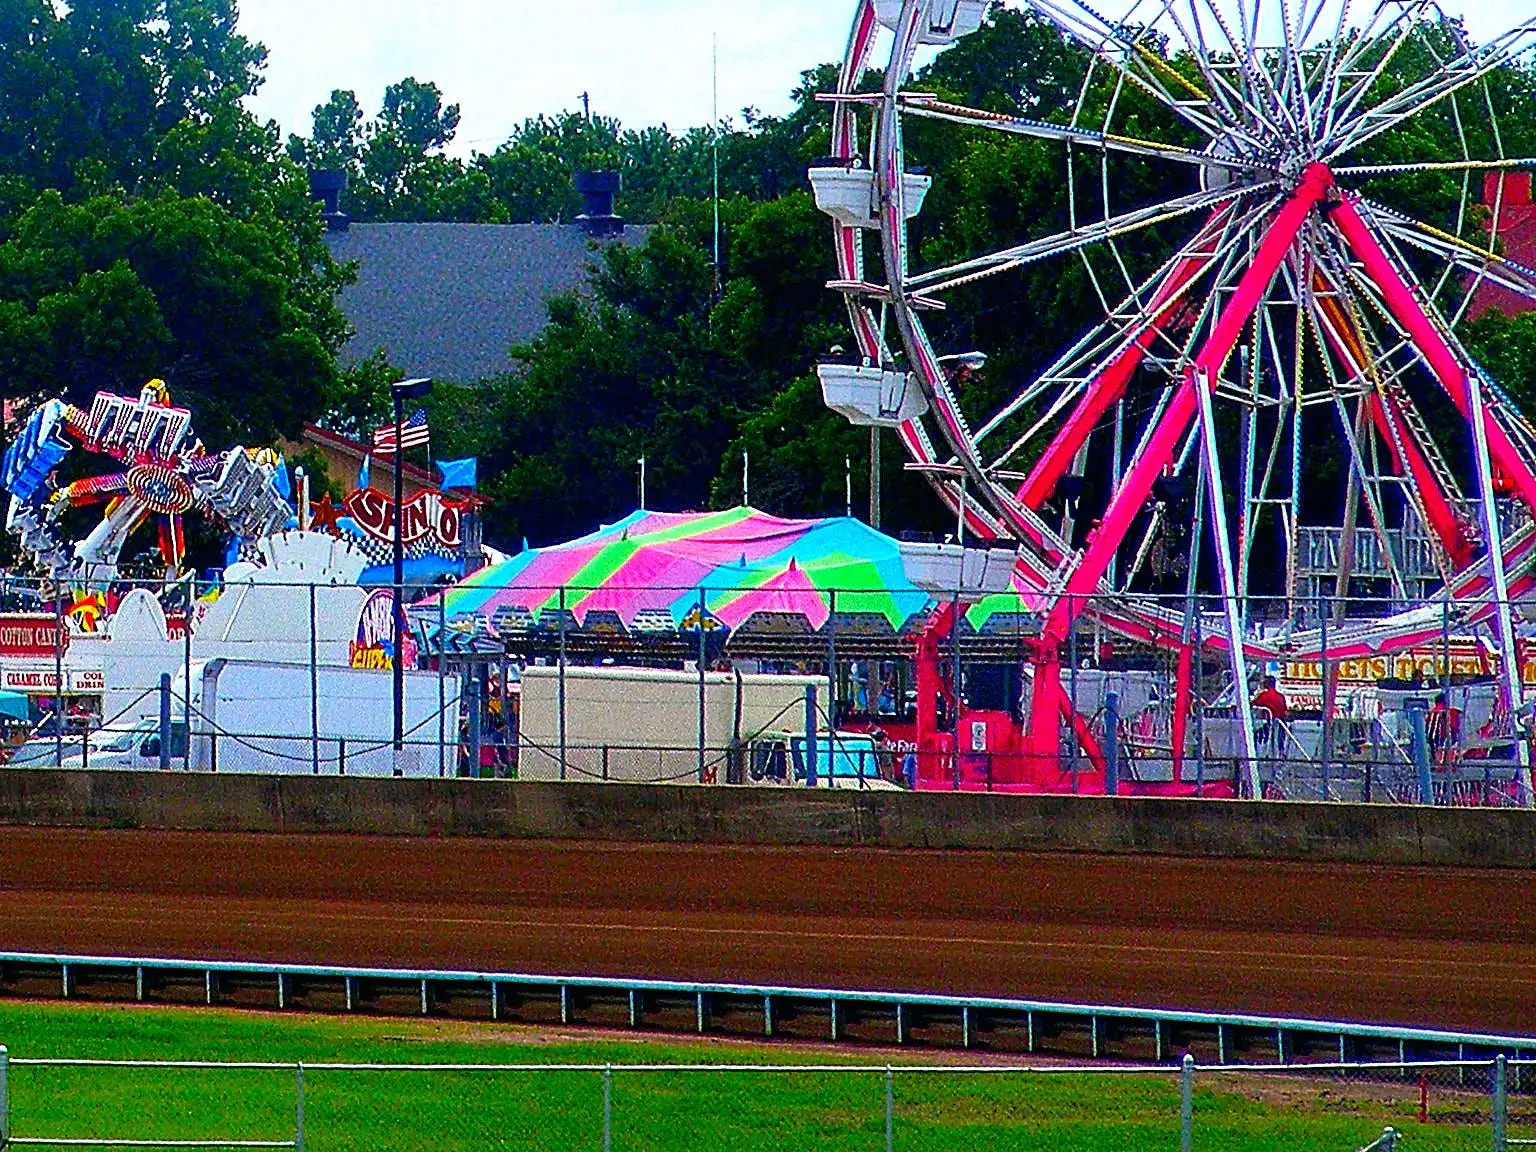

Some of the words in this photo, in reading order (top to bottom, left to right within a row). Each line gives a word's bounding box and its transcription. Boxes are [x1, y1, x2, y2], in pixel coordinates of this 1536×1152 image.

[944, 533, 953, 543] 7
[0, 627, 33, 646] COTTON
[35, 627, 63, 646] CAN
[1290, 657, 1386, 680] TICETS
[44, 673, 63, 686] COR
